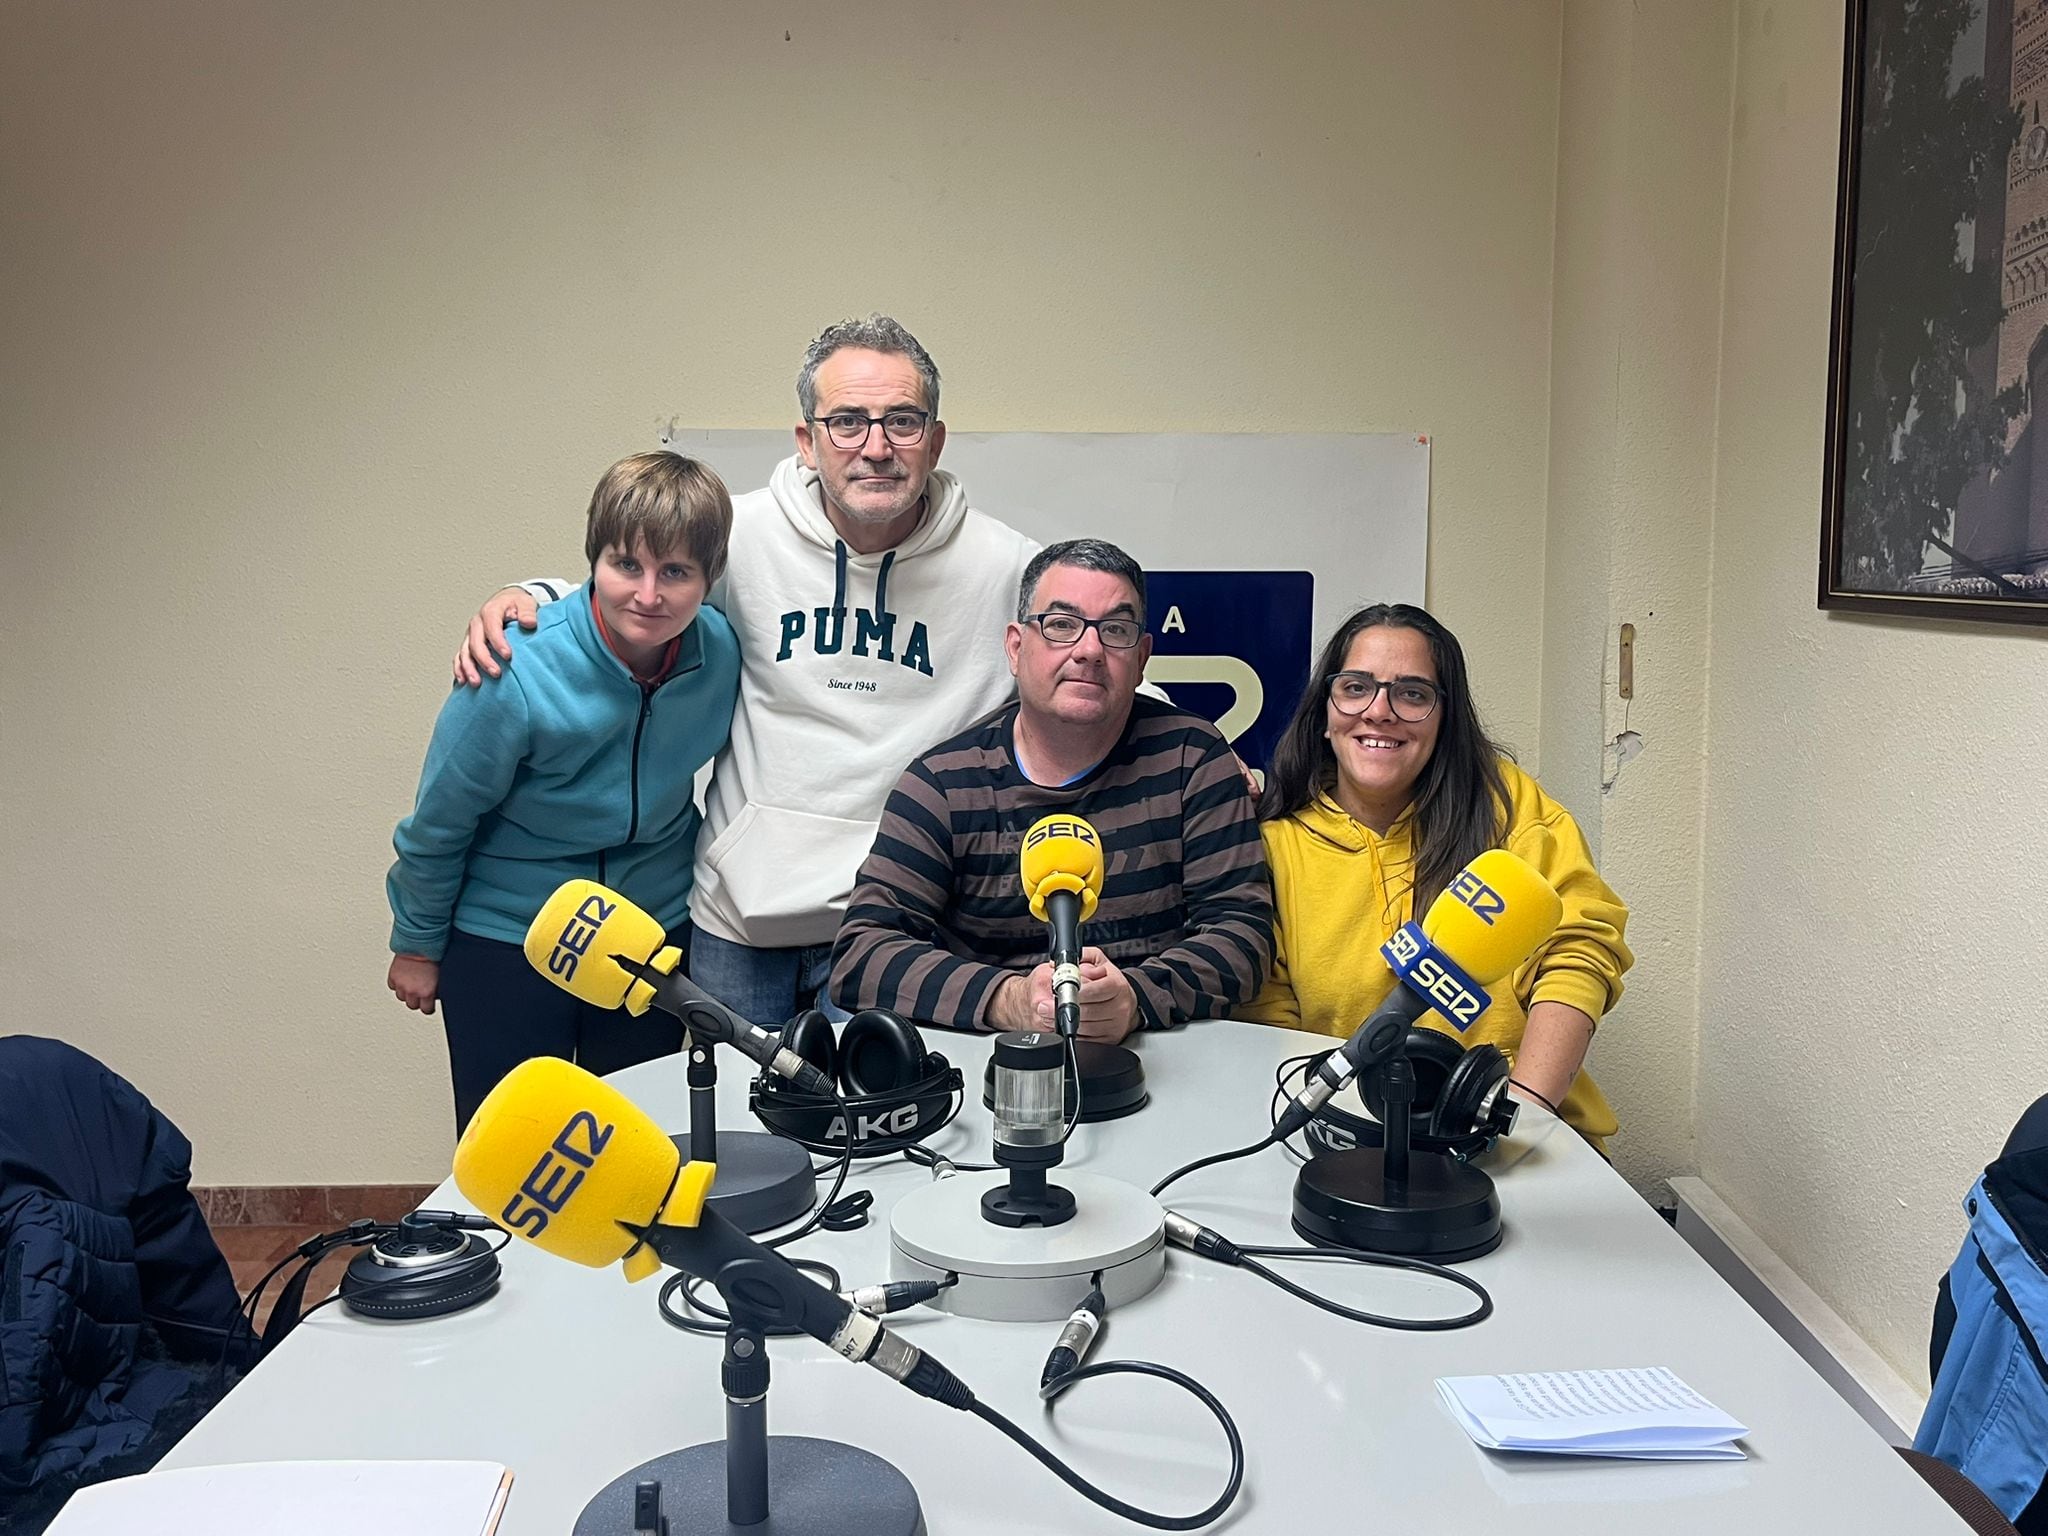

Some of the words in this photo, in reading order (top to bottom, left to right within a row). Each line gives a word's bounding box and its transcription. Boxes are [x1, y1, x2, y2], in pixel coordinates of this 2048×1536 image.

[776, 606, 934, 677] PUMA
[827, 678, 853, 690] Since
[854, 681, 877, 692] 1948
[1027, 822, 1096, 851] SER
[548, 895, 617, 982] SER
[1409, 957, 1481, 1024] SER
[824, 1103, 920, 1141] AKG
[501, 1110, 615, 1239] SER
